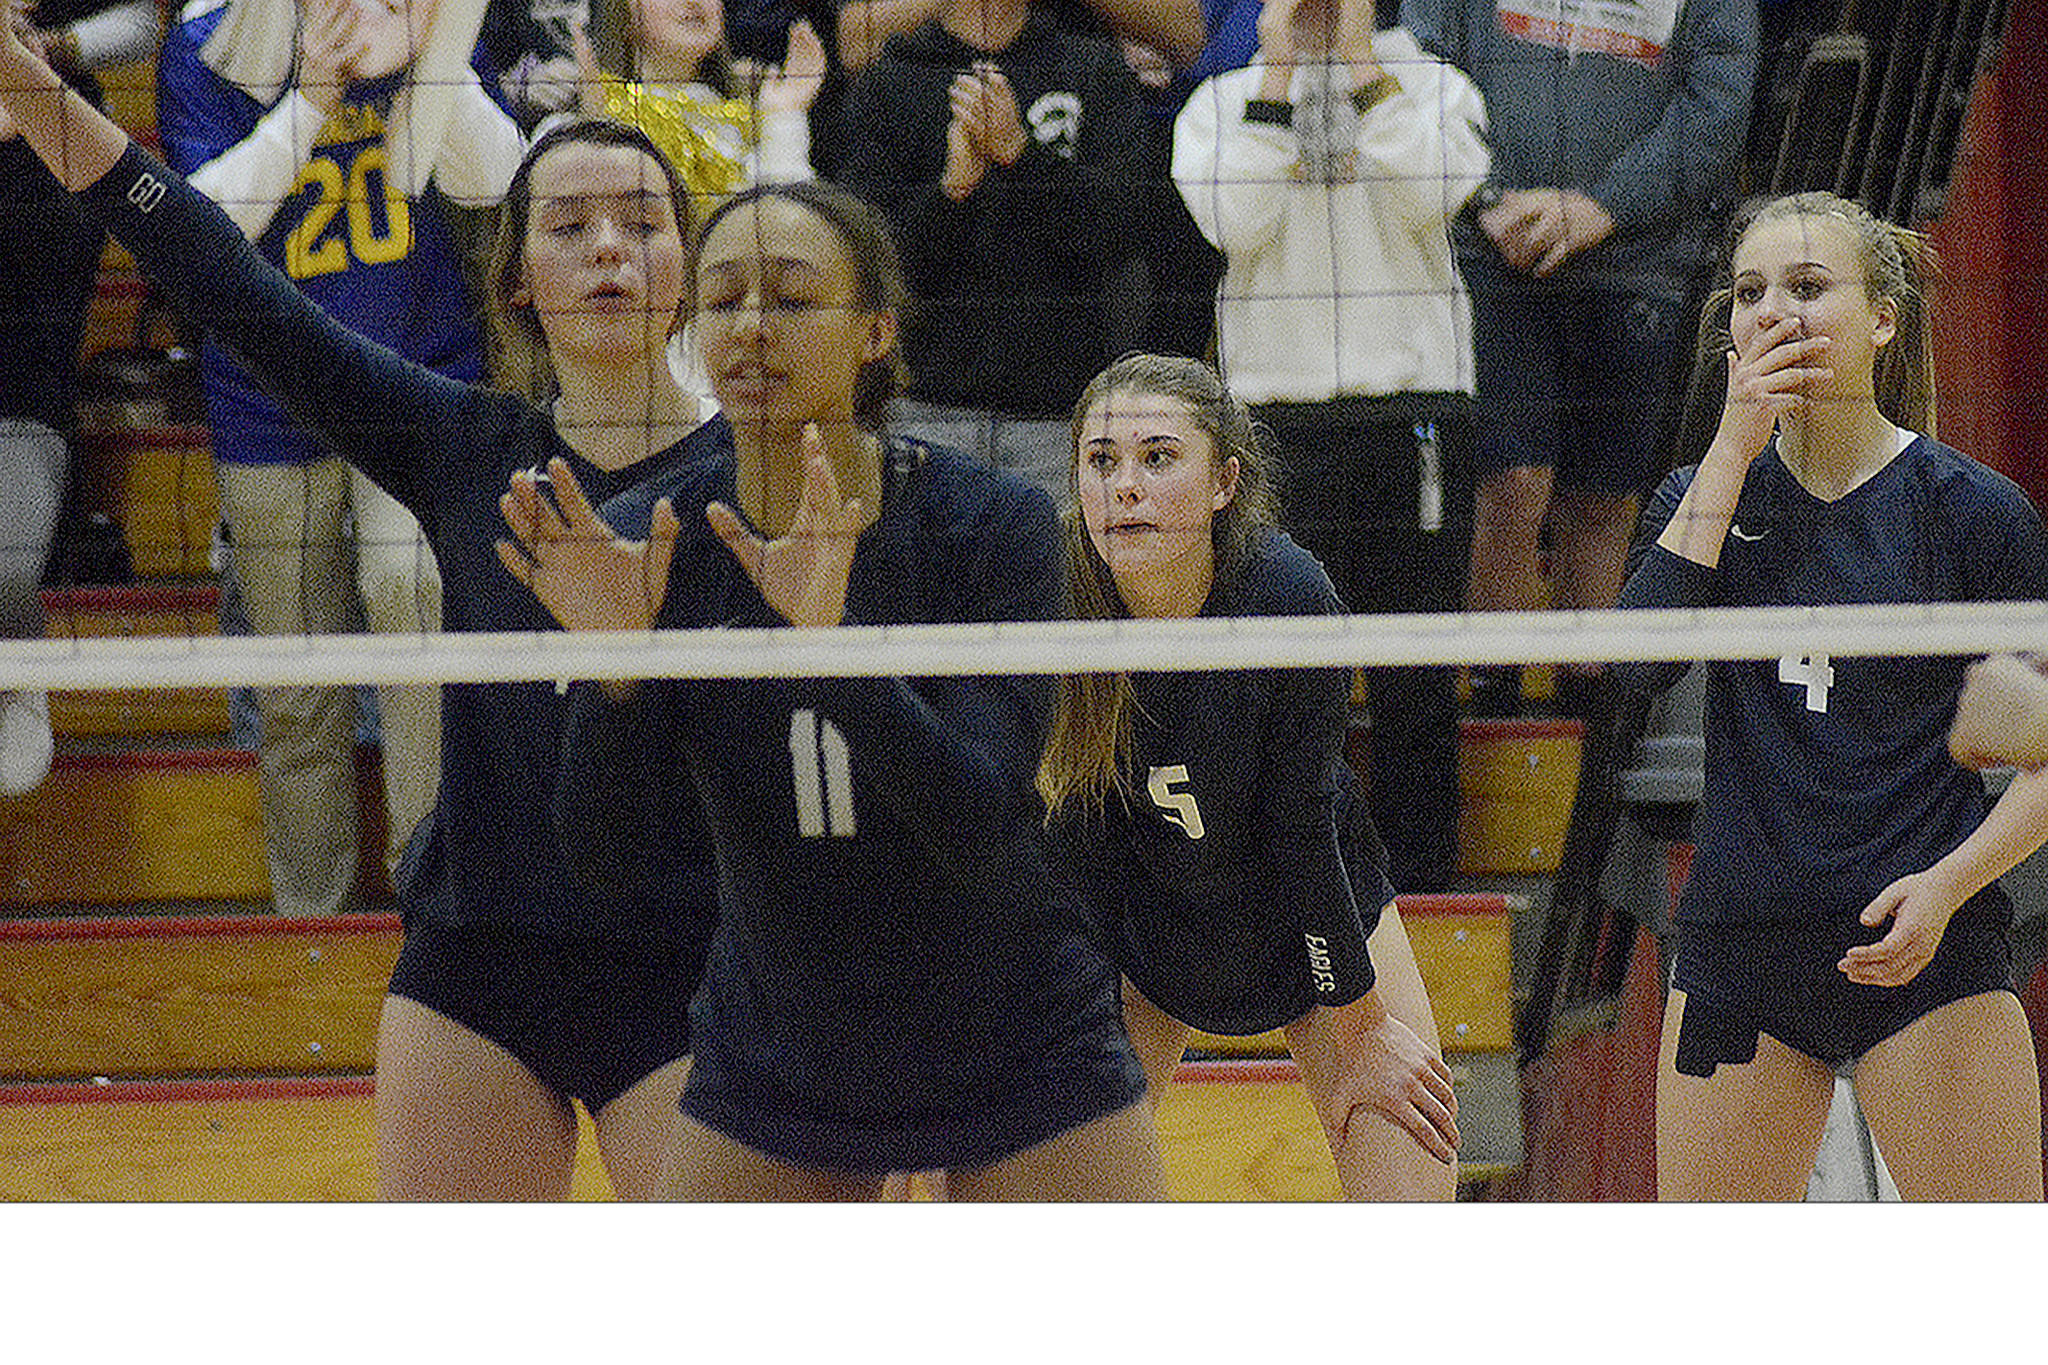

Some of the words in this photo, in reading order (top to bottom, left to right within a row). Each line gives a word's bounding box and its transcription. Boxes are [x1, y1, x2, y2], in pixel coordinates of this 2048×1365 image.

[127, 173, 166, 214] GO
[284, 147, 413, 279] 20
[1779, 655, 1834, 713] 4
[789, 708, 858, 838] 11
[1148, 764, 1205, 839] 5
